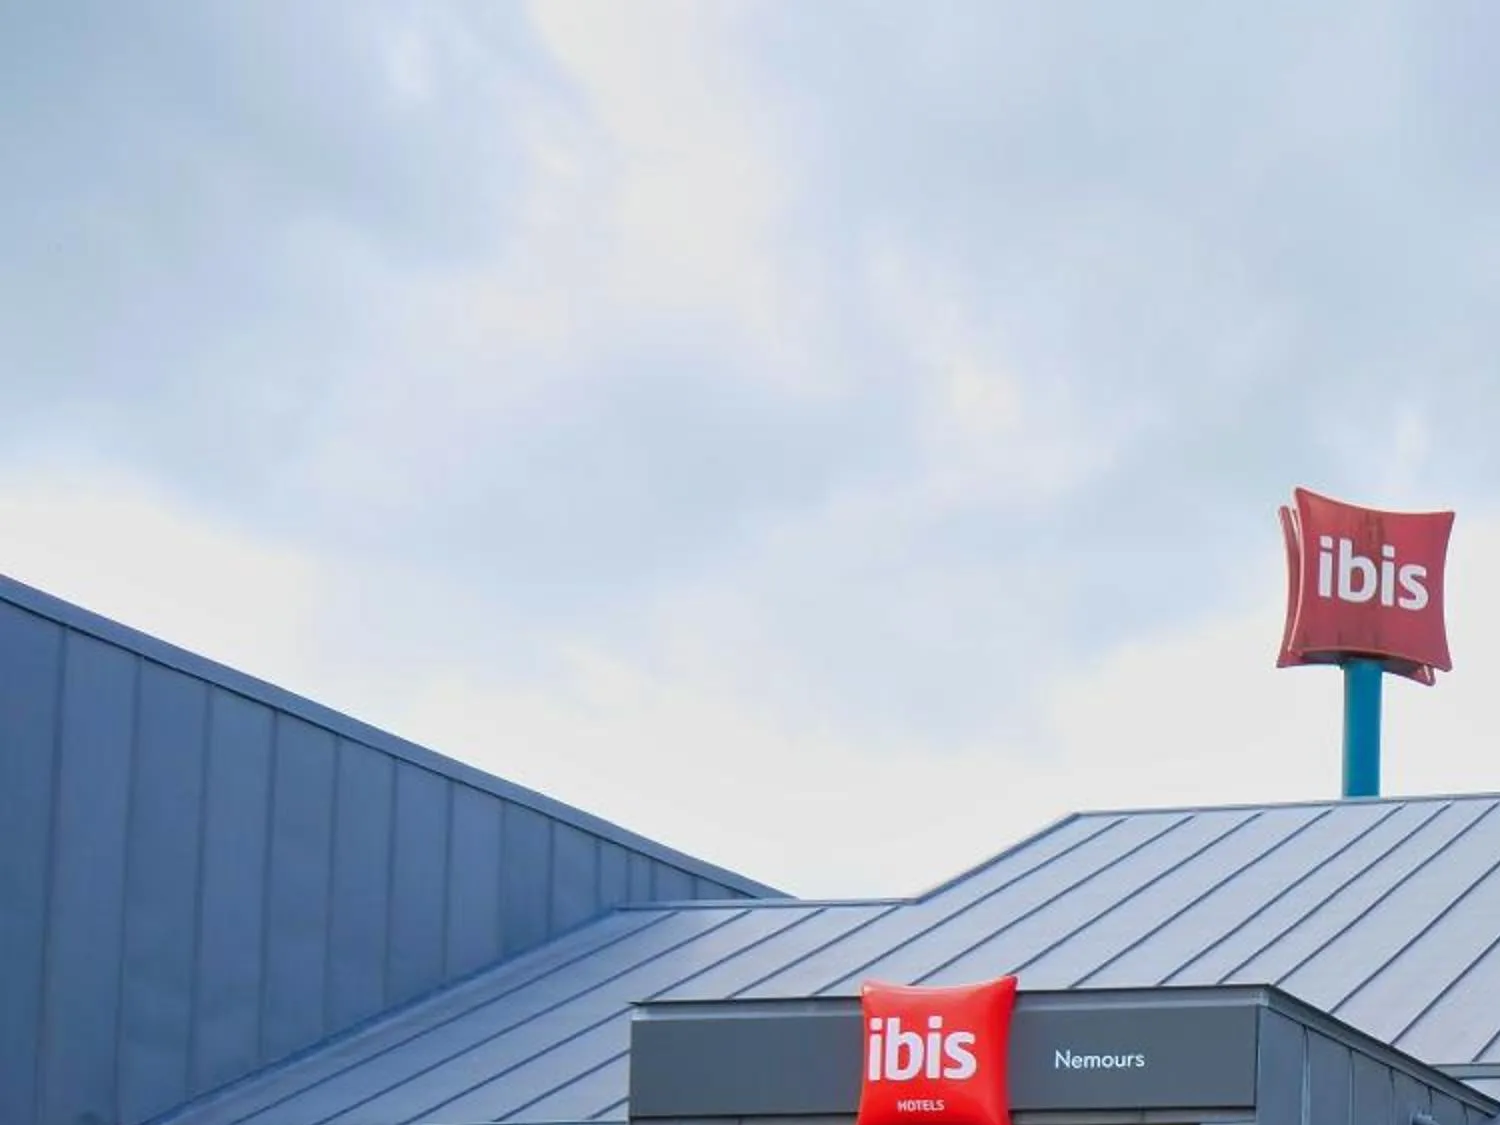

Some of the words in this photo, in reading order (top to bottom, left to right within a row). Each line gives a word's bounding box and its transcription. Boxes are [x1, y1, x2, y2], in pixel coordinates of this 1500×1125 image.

[1317, 535, 1429, 611] ibis
[868, 1015, 976, 1081] ibis
[1054, 1049, 1145, 1069] Nemours
[897, 1099, 944, 1112] HOTELS
